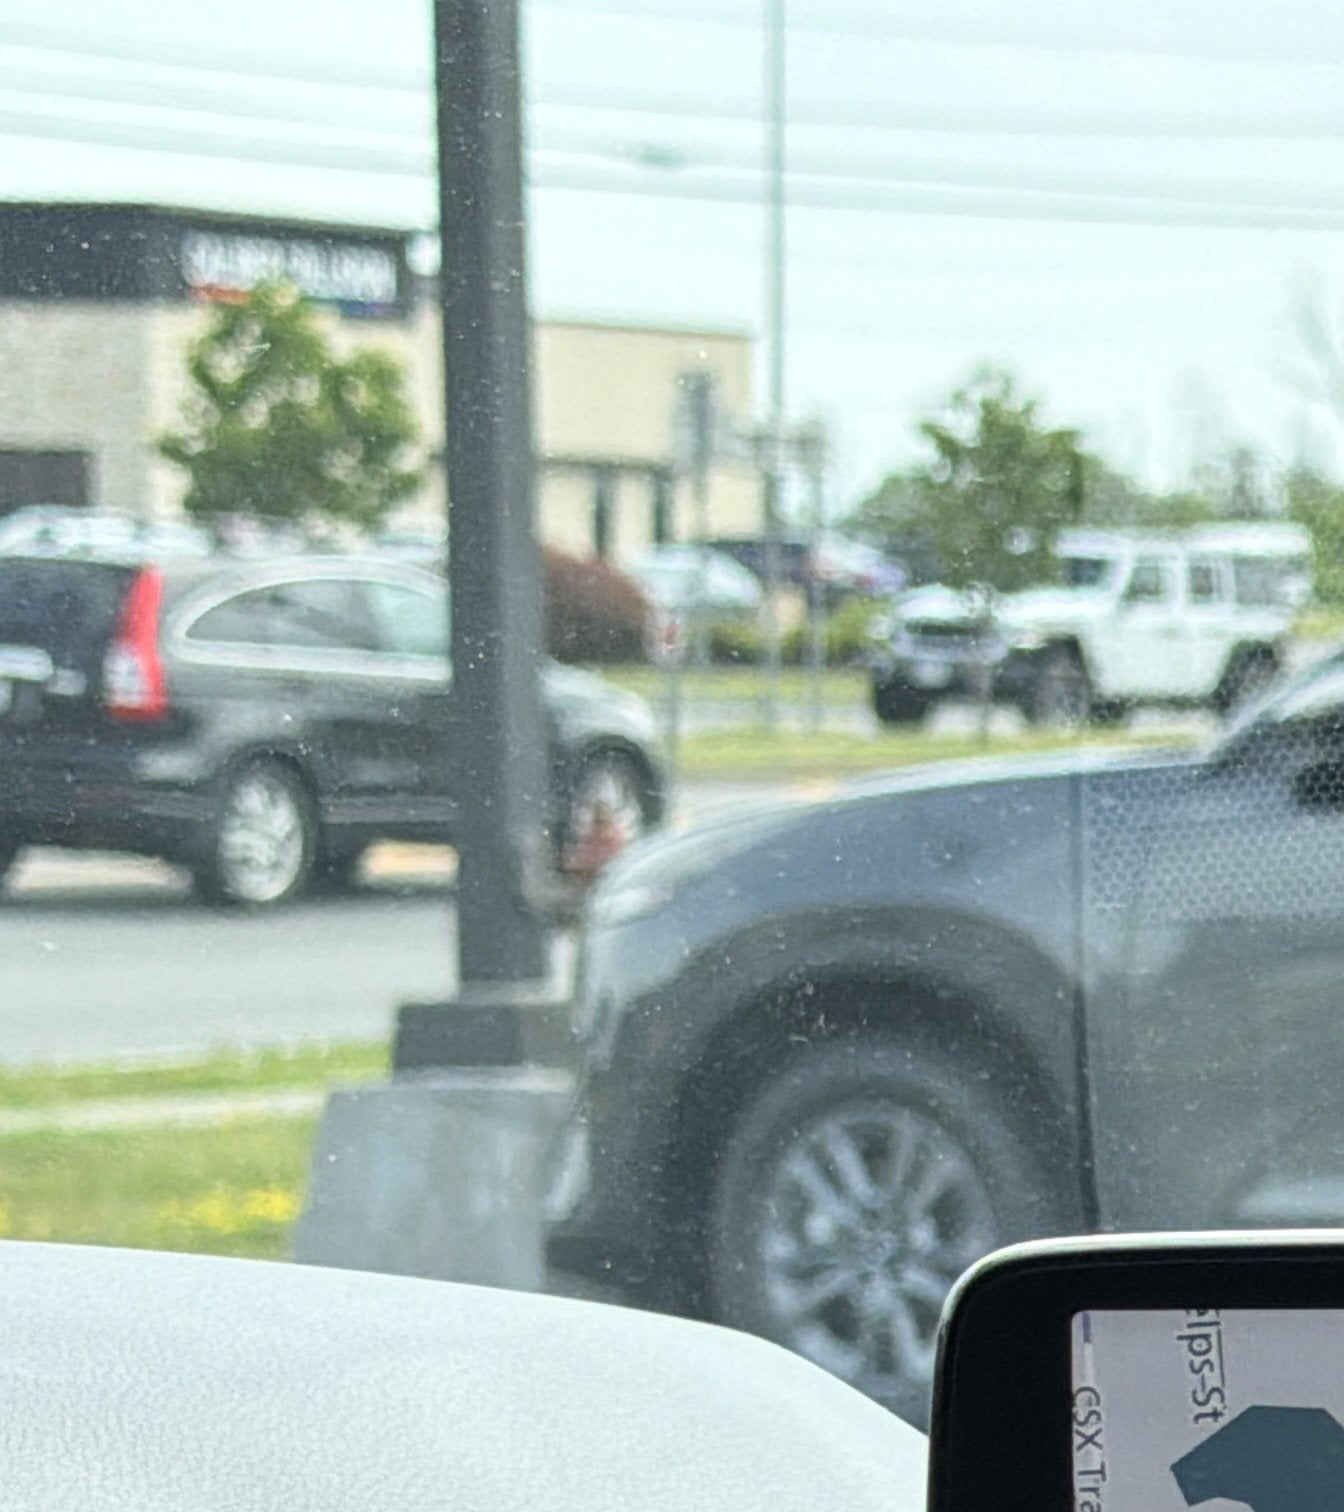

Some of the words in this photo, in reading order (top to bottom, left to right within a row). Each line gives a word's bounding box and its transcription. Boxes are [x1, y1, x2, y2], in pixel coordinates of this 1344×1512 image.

[1176, 1309, 1222, 1374] lps
[1073, 1386, 1103, 1451] CSX
[1191, 1386, 1226, 1425] St
